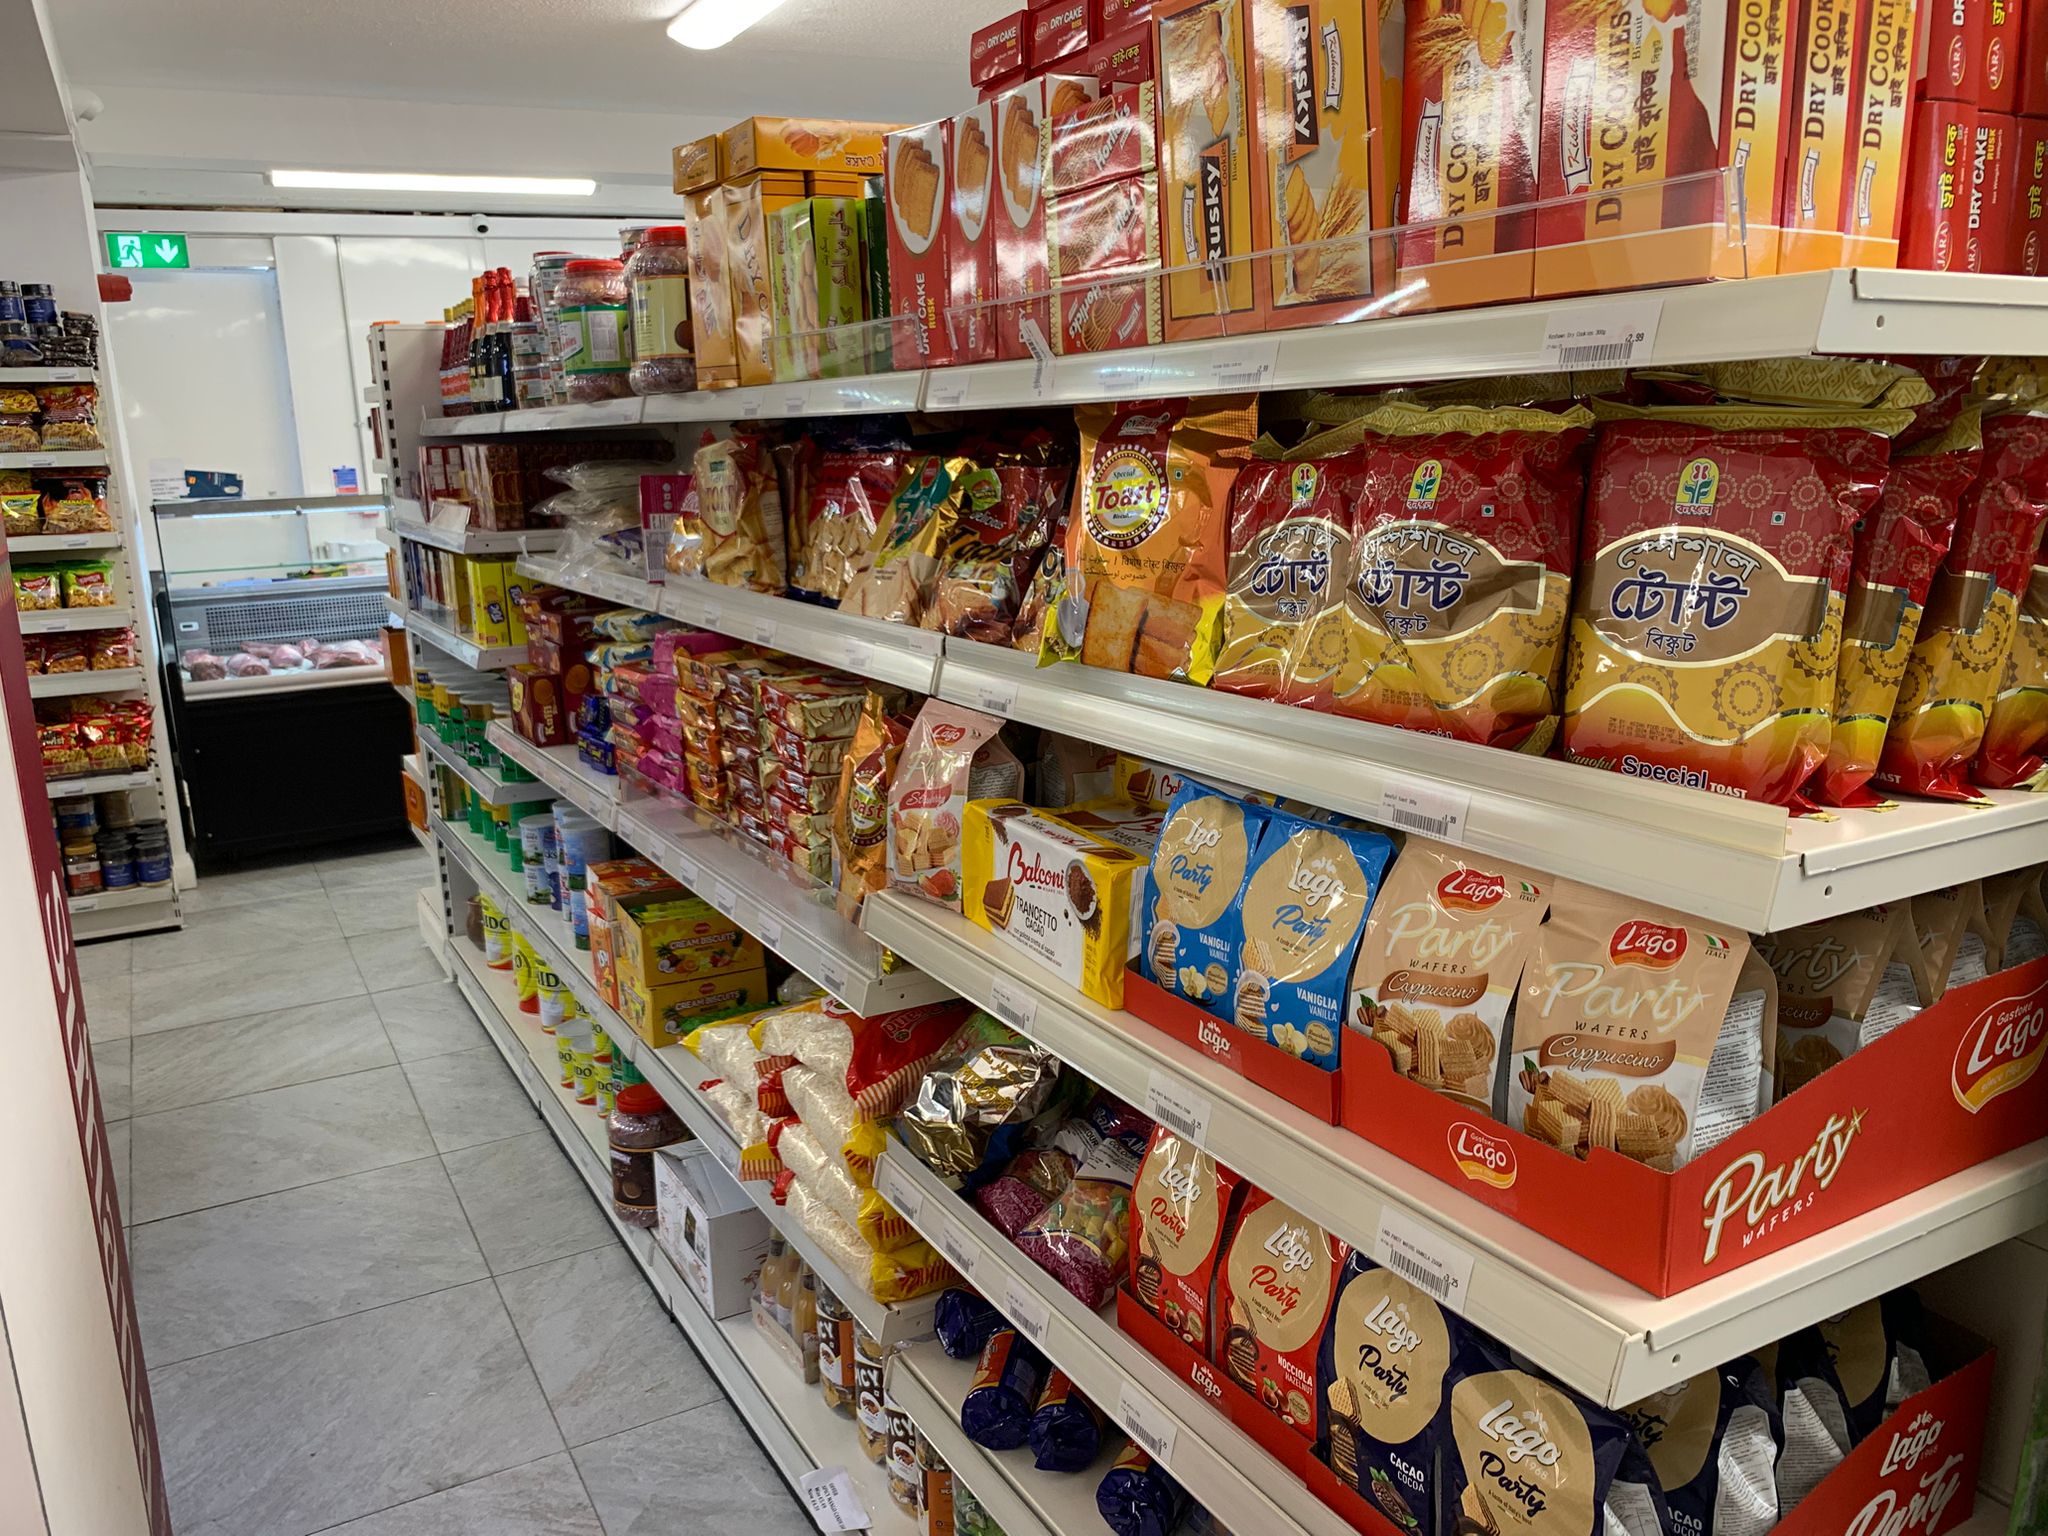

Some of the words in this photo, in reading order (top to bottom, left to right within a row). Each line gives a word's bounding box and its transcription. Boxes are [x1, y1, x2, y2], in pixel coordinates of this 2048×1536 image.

[1050, 15, 1064, 29] DRY
[1064, 6, 1083, 22] CAKE
[1952, 0, 1965, 26] DR
[987, 36, 999, 49] DRY
[999, 26, 1017, 41] CAKE
[1632, 16, 1644, 60] Biscuit
[1809, 0, 1833, 75] COOK
[1869, 0, 1894, 87] COOKI
[1951, 41, 1962, 82] JARA
[1989, 45, 2001, 83] JARA
[1735, 72, 1758, 131] DRY
[1804, 83, 1828, 140] DRY
[1862, 94, 1886, 151] DRY
[1973, 126, 1989, 185] CAKE
[1987, 128, 1997, 161] RUSK
[1221, 142, 1229, 189] Cookies
[1596, 160, 1625, 225] DRY
[1968, 189, 1983, 229] DRY
[1443, 193, 1465, 250] DRY
[1937, 226, 1949, 267] JARA
[1967, 243, 1978, 273] ARA
[915, 272, 927, 320] CAKE
[927, 297, 937, 330] RUSK
[1067, 283, 1102, 340] Horlicks
[1095, 480, 1156, 510] Toast
[1357, 557, 1471, 613] টোস্ট
[1609, 566, 1751, 631] টোস্ট
[932, 724, 960, 741] Lago
[1621, 754, 1709, 792] Special
[1710, 781, 1749, 799] TOAST
[1872, 771, 1902, 785] OAST
[852, 798, 886, 820] oast
[1007, 841, 1065, 890] Balconi
[1170, 854, 1214, 893] Party
[1287, 856, 1348, 906] Lago
[1444, 868, 1503, 902] Lago
[485, 916, 511, 931] IDO
[1016, 896, 1058, 931] TRANCETTO
[1025, 916, 1045, 938] CACAO
[1272, 904, 1332, 947] Party
[670, 939, 700, 950] CREAM
[1209, 948, 1230, 962] VANILL
[1384, 902, 1510, 971] Party
[1617, 924, 1677, 955] Lago
[1704, 949, 1730, 960] ITALY
[1409, 959, 1468, 974] WAFERS
[1752, 936, 1860, 992] arty
[1297, 987, 1338, 1011] VANIGLIA
[1386, 972, 1480, 1004] Cappuccino
[1541, 961, 1702, 1034] Party
[1778, 983, 1806, 995] ERS
[1309, 1005, 1338, 1022] VANILLA
[1575, 1020, 1649, 1040] WAFERS
[1996, 1001, 2034, 1026] Gastone
[1198, 1020, 1231, 1054] Lago
[1547, 1035, 1665, 1072] Cappuccino
[1966, 1006, 2045, 1076] Lago
[1457, 1127, 1508, 1170] Lago
[1158, 1158, 1202, 1203] Lago
[1703, 1112, 1860, 1265] Party
[1151, 1196, 1188, 1243] Party
[1742, 1190, 1815, 1249] WAFERS
[1263, 1222, 1315, 1273] Lago
[1248, 1264, 1302, 1316] Party
[1363, 1295, 1422, 1354] Lago
[856, 1367, 881, 1388] ICY
[1190, 1361, 1223, 1398] Lago
[1277, 1354, 1314, 1387] NOCCIOLA
[1284, 1370, 1314, 1397] HAZELNUT
[1358, 1344, 1411, 1403] Party
[1478, 1399, 1563, 1467] Lago
[1619, 1407, 1669, 1450] arty
[1880, 1420, 1945, 1477] Lago
[1389, 1452, 1426, 1482] CACAO
[1397, 1471, 1426, 1494] COCOA
[1479, 1450, 1547, 1518] Party
[1524, 1458, 1549, 1481] 1968
[1843, 1452, 1964, 1536] Party
[1670, 1508, 1703, 1530] CAO
